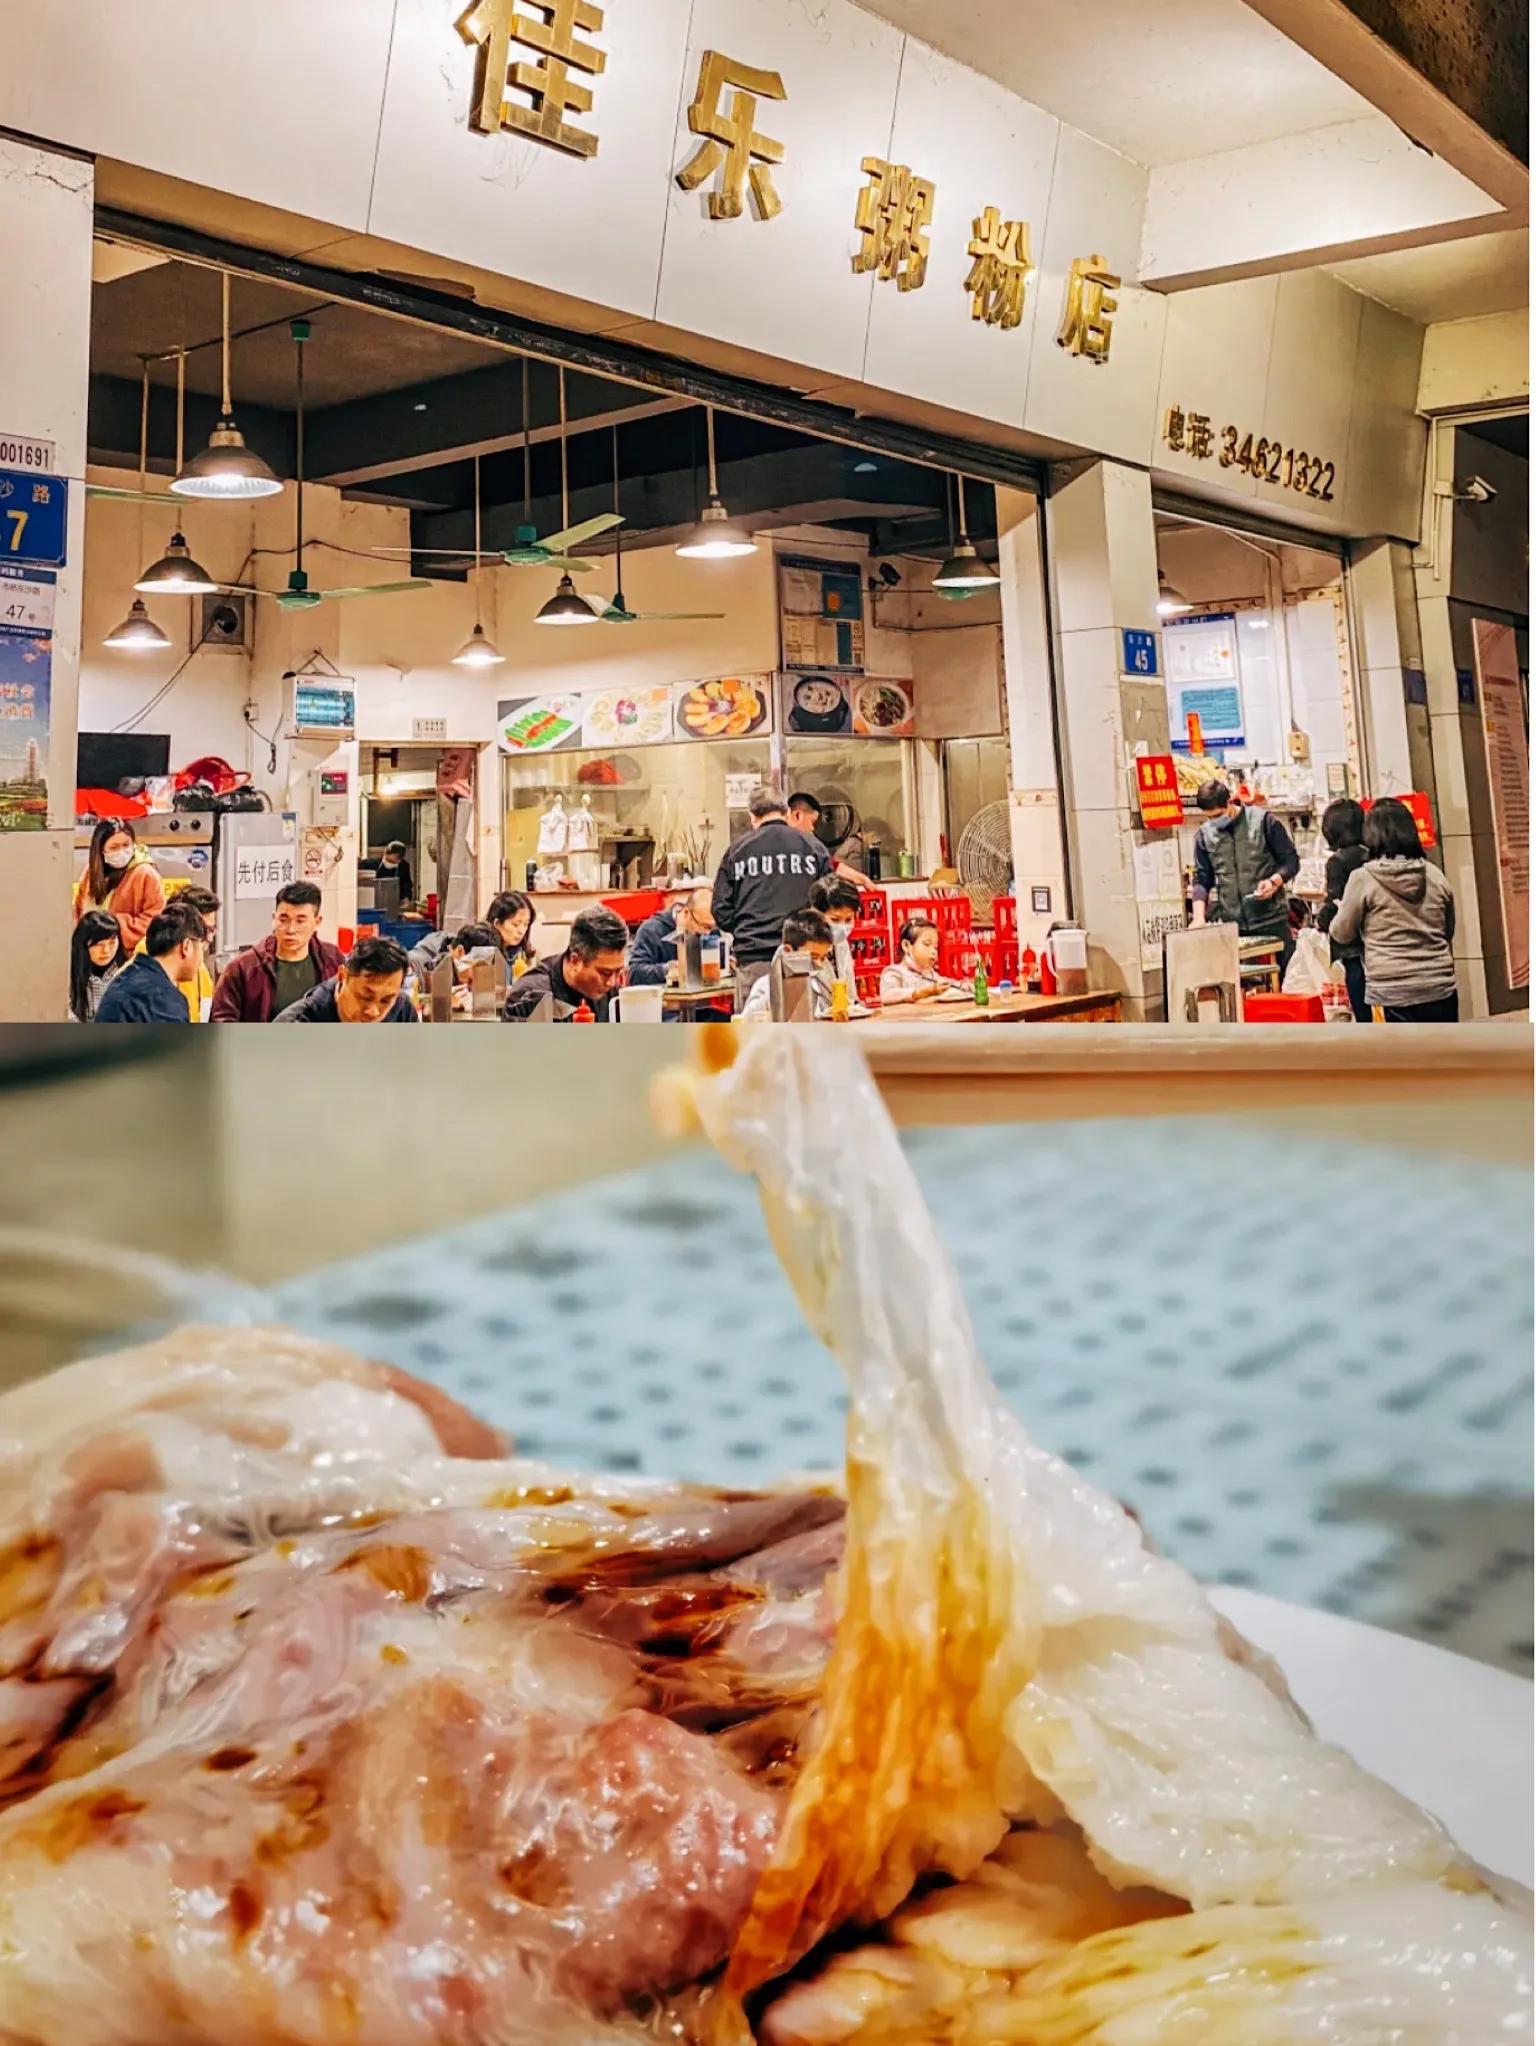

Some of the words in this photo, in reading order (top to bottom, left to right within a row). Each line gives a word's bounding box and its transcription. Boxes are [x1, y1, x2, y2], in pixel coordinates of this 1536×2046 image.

[0, 442, 49, 469] 001691
[1219, 425, 1336, 502] 34621322
[0, 509, 28, 552] 7
[1135, 649, 1148, 671] 45
[237, 859, 294, 884] 先付后食
